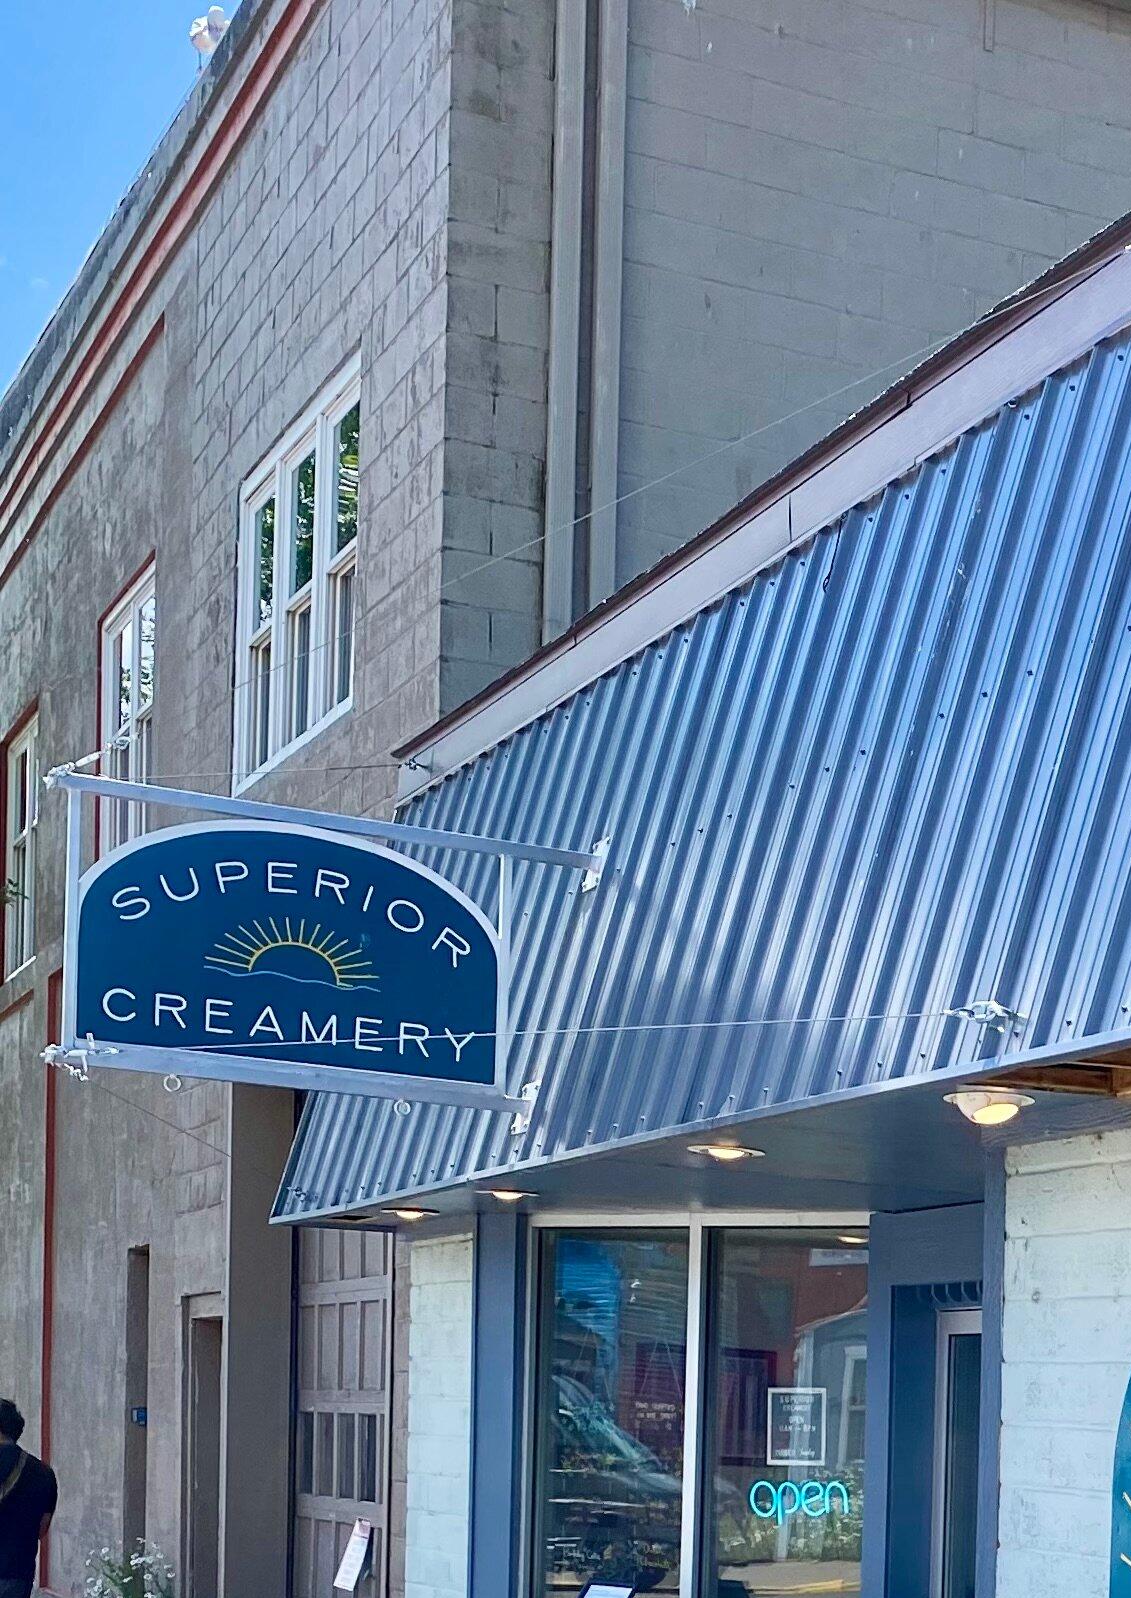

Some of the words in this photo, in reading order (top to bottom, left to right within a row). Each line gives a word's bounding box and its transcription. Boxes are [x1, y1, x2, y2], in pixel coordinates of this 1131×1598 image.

[111, 860, 471, 969] SUPERIOR
[102, 987, 476, 1063] CREAMERY
[749, 1480, 849, 1525] open
